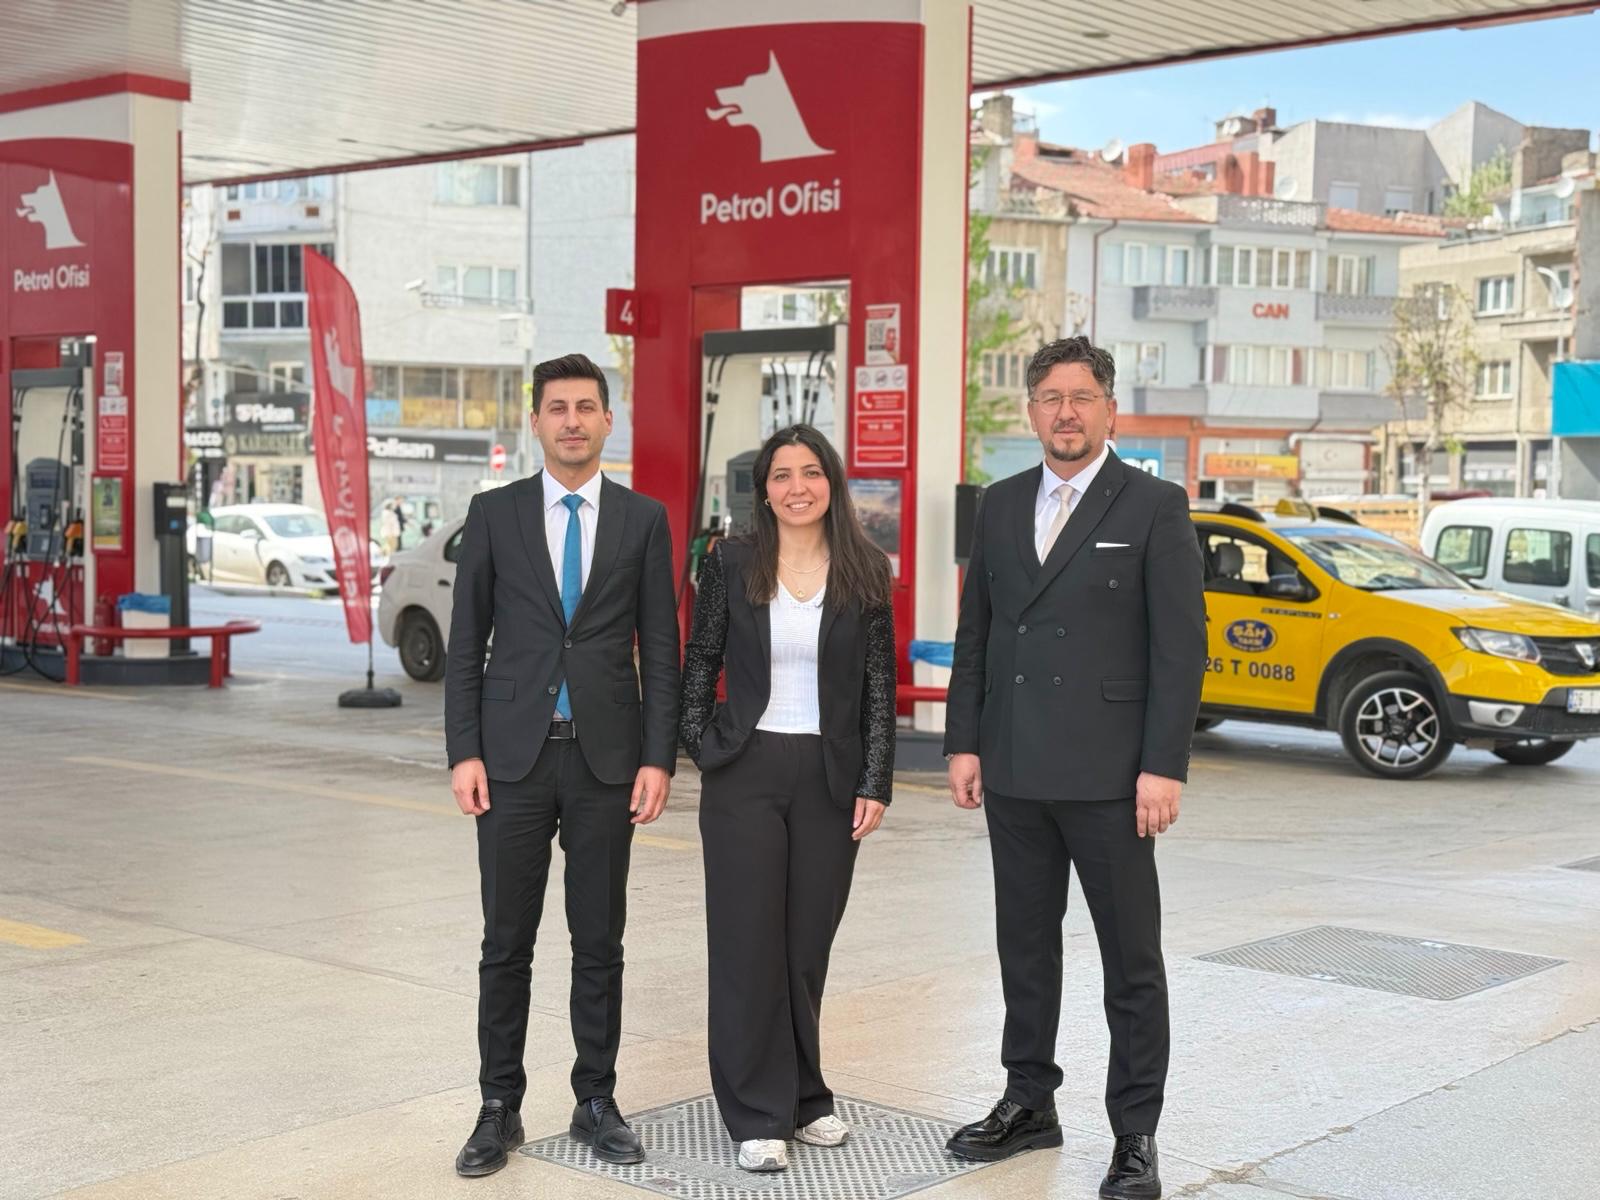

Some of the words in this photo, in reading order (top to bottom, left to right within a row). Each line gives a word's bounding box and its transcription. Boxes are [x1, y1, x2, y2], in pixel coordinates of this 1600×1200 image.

[700, 187, 774, 224] Petrol
[779, 178, 841, 216] Ofisi
[14, 267, 54, 292] Petrol
[56, 263, 90, 289] Ofisi
[620, 299, 634, 325] 4
[1252, 302, 1289, 319] CAN
[1205, 657, 1224, 673] 26
[1230, 659, 1242, 675] T
[1248, 661, 1296, 682] 0088
